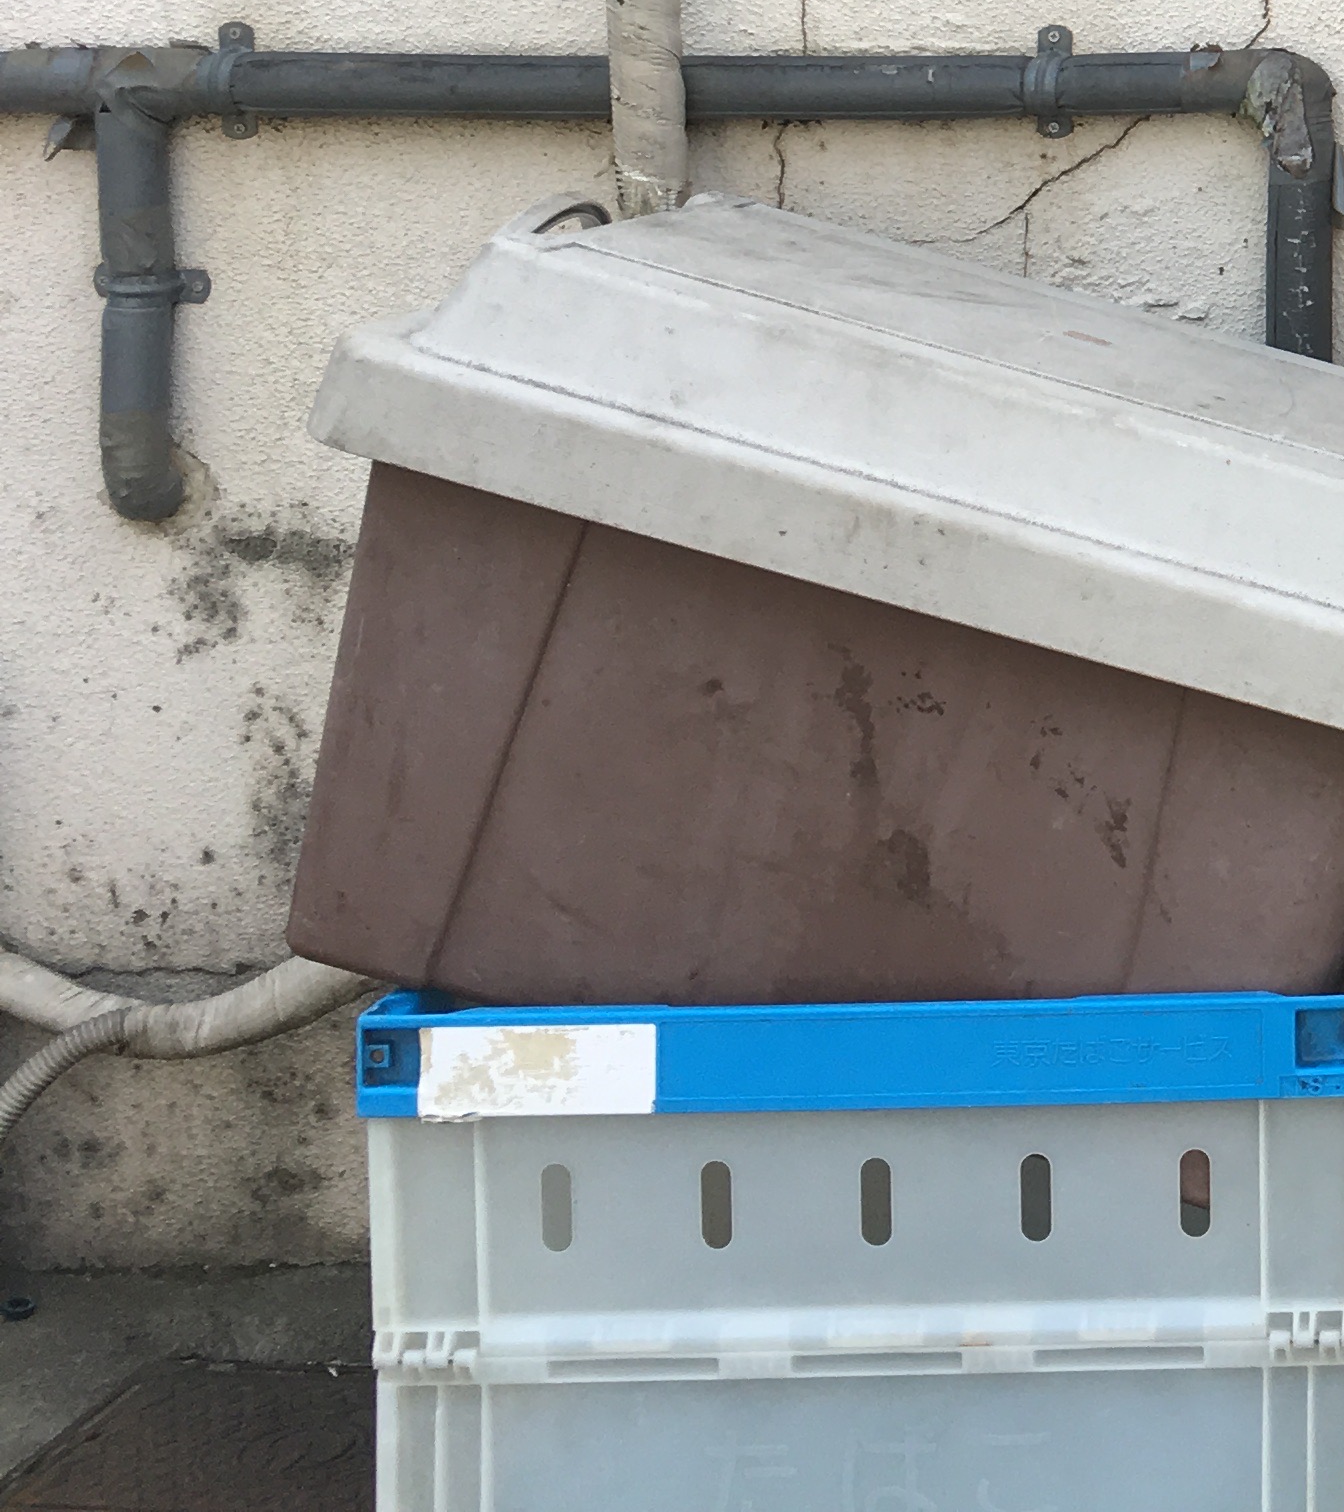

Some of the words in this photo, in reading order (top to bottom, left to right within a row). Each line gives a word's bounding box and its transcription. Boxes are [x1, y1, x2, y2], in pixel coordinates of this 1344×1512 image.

[991, 1035, 1233, 1068] 東京たばこサービス
